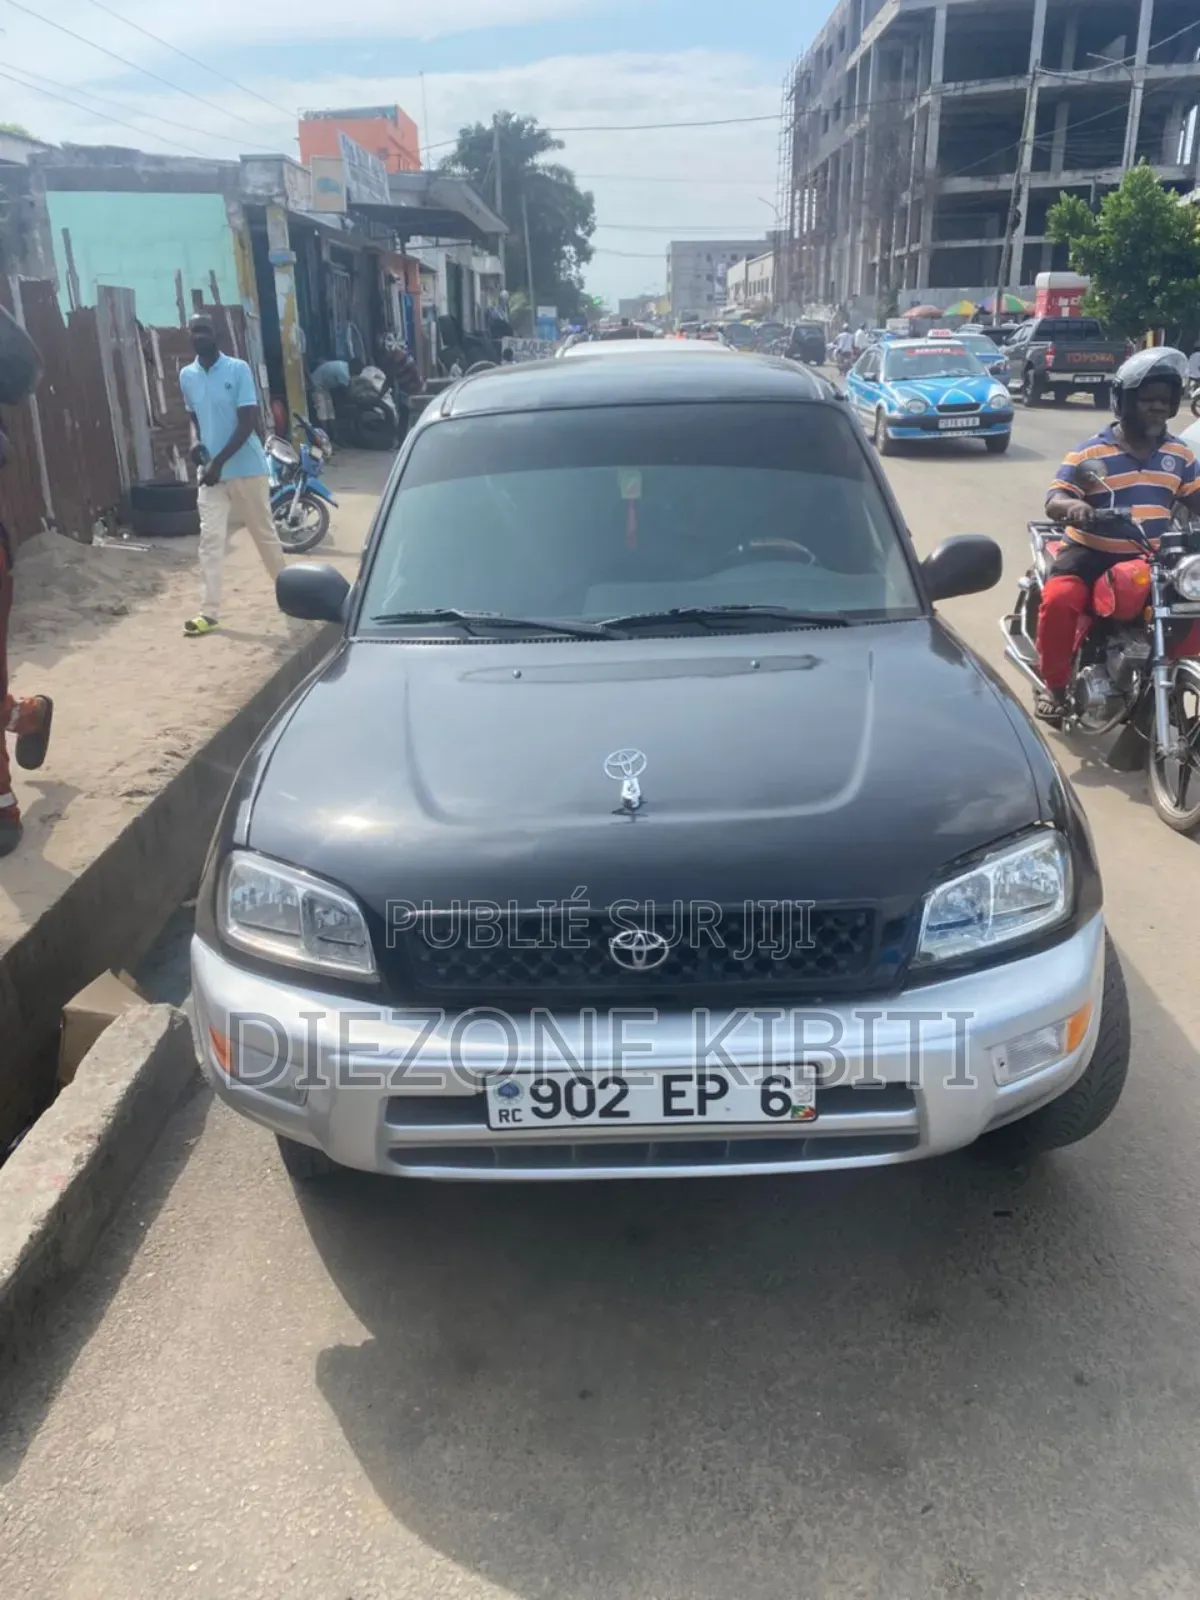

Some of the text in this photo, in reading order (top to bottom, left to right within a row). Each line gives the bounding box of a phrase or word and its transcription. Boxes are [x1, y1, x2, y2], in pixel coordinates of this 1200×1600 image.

[529, 1073, 792, 1120] 902 EP 6
[498, 1108, 523, 1123] RC
